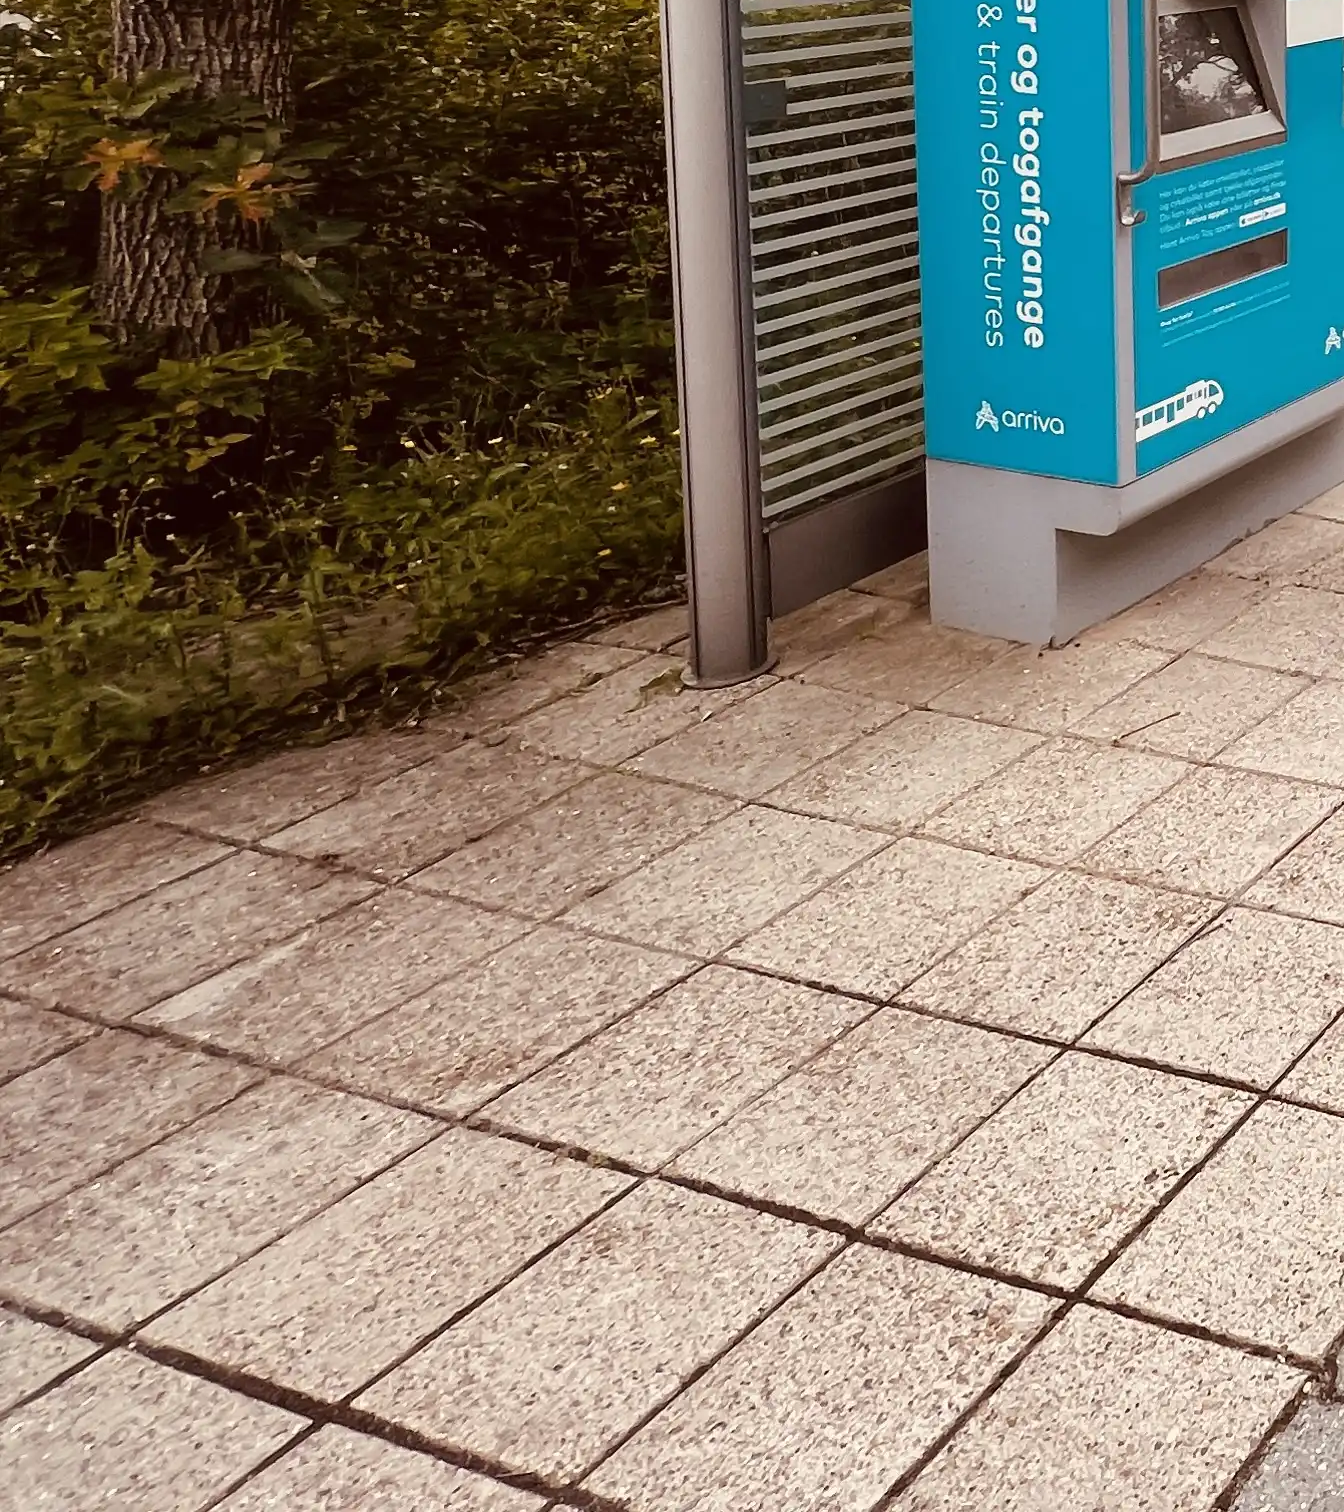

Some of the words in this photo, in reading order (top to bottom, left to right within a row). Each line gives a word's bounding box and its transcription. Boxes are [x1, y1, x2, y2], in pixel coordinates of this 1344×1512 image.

[977, 3, 1002, 28] &
[978, 41, 1004, 129] train
[1010, 43, 1038, 95] og
[976, 142, 1007, 347] departures
[1012, 107, 1050, 348] togafgange
[1002, 410, 1065, 435] arriva
